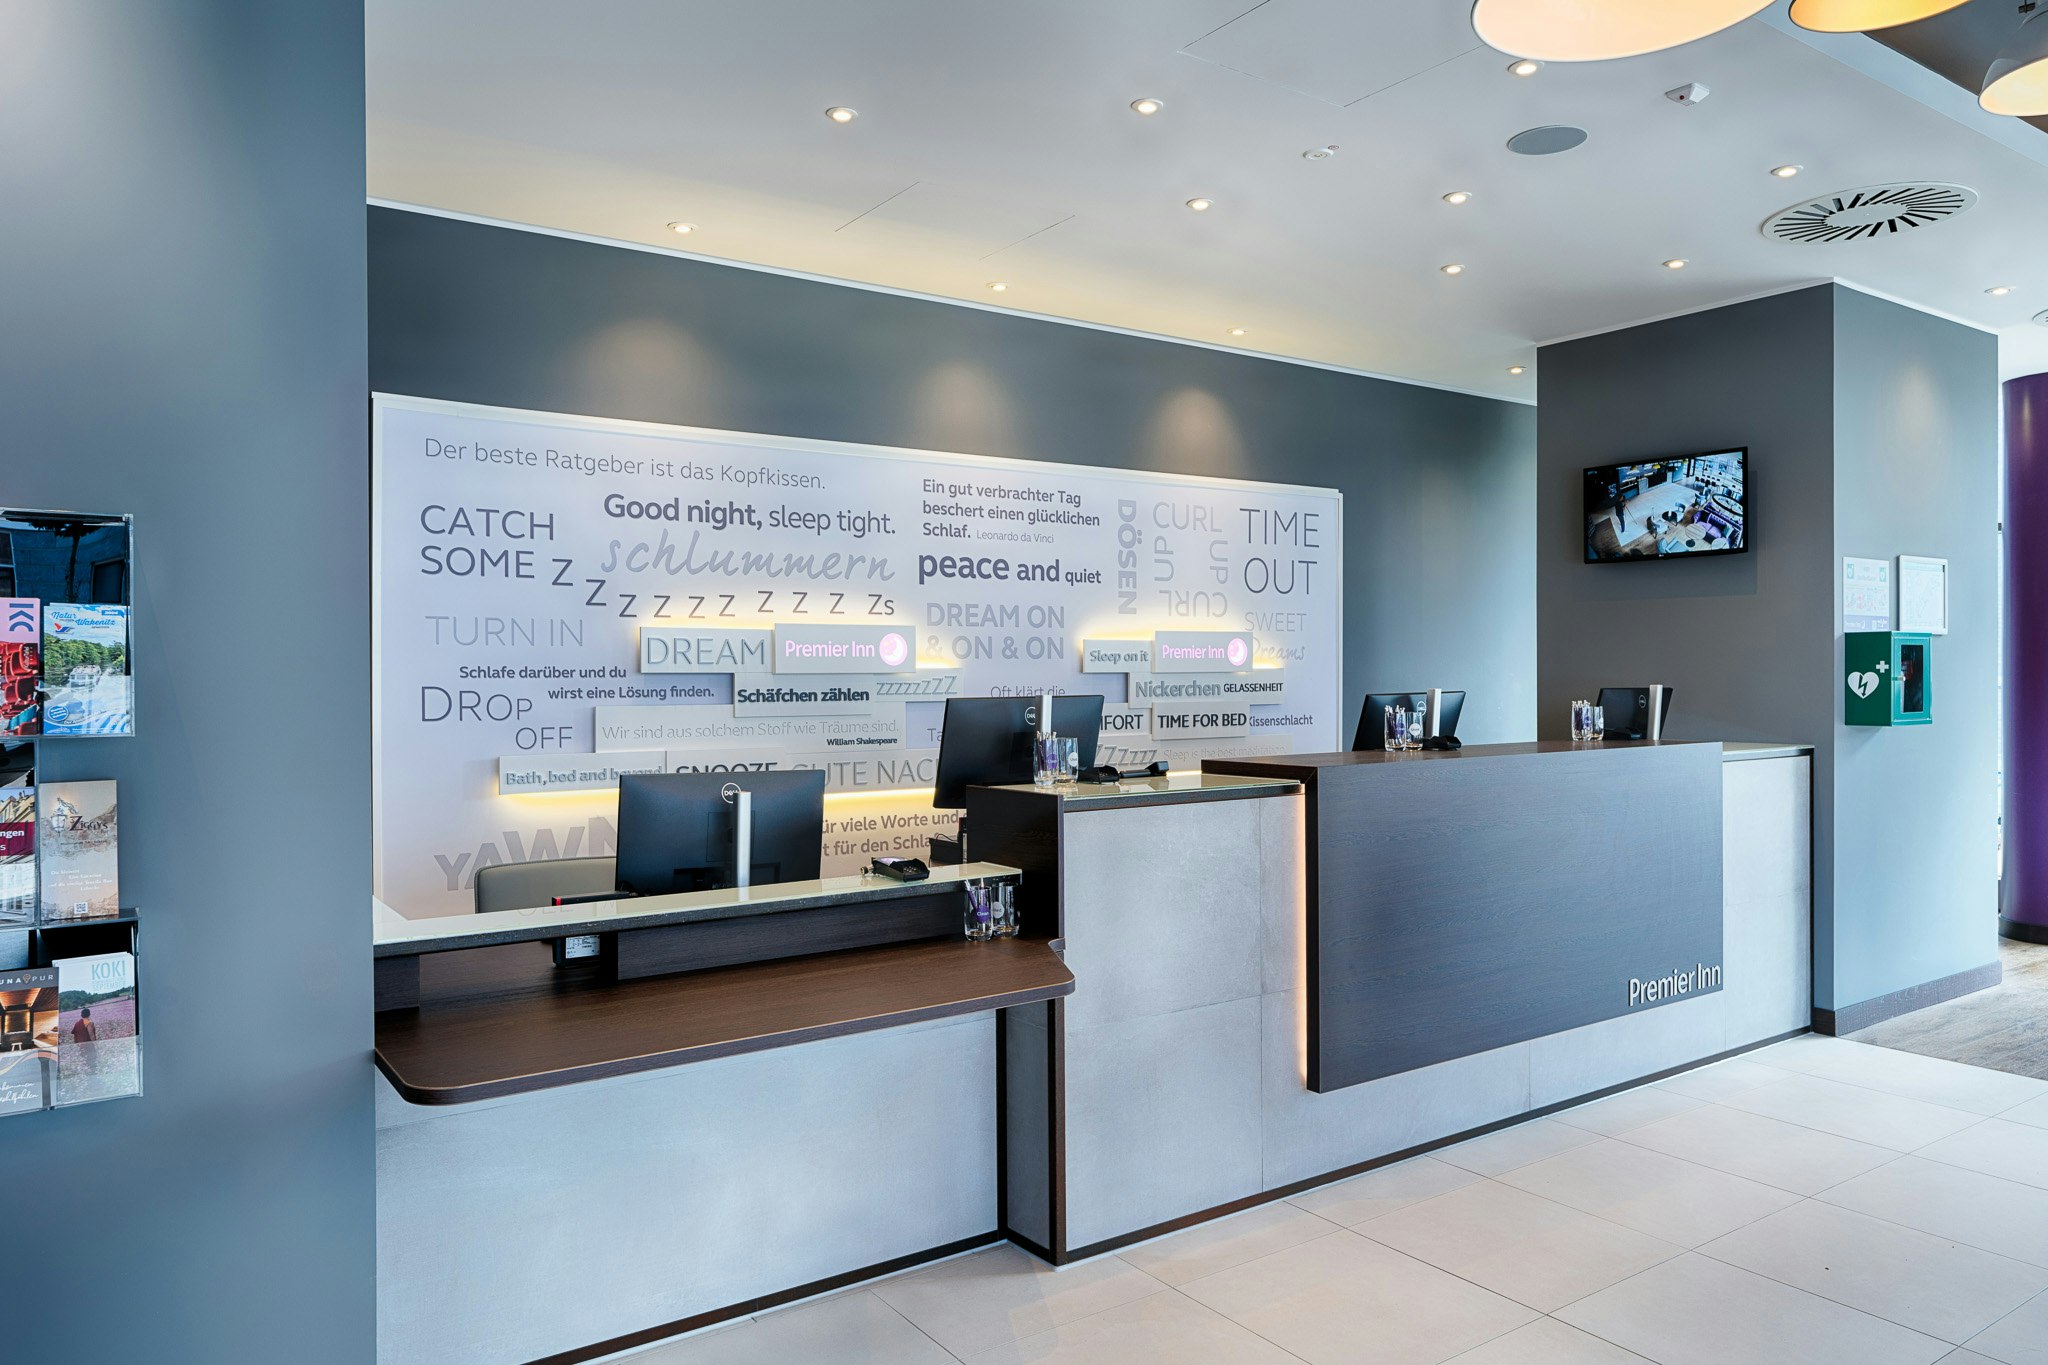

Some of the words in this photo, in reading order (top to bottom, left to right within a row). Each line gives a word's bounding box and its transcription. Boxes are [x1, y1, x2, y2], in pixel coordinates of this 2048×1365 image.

[424, 438, 467, 461] Der
[475, 443, 538, 467] beste
[546, 449, 644, 476] Ratgeber
[650, 460, 675, 479] ist
[680, 462, 715, 482] das
[720, 464, 826, 490] Kopfkissen.
[922, 479, 945, 494] Ein
[949, 483, 972, 498] gut
[976, 485, 1054, 503] verbrachter
[1058, 490, 1081, 508] Tag
[420, 504, 555, 541] CATCH
[603, 493, 680, 522] Good
[686, 500, 763, 532] night,
[768, 505, 831, 535] sleep
[837, 509, 896, 538] tight.
[922, 500, 984, 518] beschert
[987, 506, 1024, 521] einen
[1027, 509, 1100, 527] glücklichen
[1152, 501, 1223, 533] CURL
[922, 522, 971, 539] Schlaf.
[976, 529, 1019, 542] Leonardo
[1020, 531, 1032, 543] da
[1034, 533, 1054, 544] Vinci
[1240, 508, 1320, 548] TIME
[600, 528, 897, 582] schlummern
[1117, 499, 1143, 615] DÖSEN
[1154, 535, 1175, 582] UP
[1209, 540, 1229, 585] UP
[420, 545, 535, 579] SOME
[551, 558, 573, 587] Z
[585, 579, 607, 607] Z
[618, 593, 638, 618] Z
[653, 595, 672, 618] Z
[687, 596, 706, 618] Z
[718, 594, 736, 616] Z
[757, 590, 775, 613] Z
[791, 591, 809, 613] Z
[828, 592, 846, 614] Z
[867, 593, 896, 616] Zs
[918, 553, 1010, 585] peace
[1016, 558, 1060, 582] and
[1064, 568, 1102, 587] quiet
[1243, 557, 1318, 596] OUT
[926, 602, 1020, 629] DREAM
[1026, 604, 1065, 629] ON
[1159, 590, 1229, 618] CURL
[425, 616, 536, 647] TURN
[549, 618, 585, 647] IN
[1244, 611, 1307, 633] SWEET
[646, 636, 766, 666] DREAM
[785, 639, 850, 659] Premier
[851, 640, 876, 657] Inn
[951, 635, 993, 660] ON
[1001, 636, 1020, 660] &
[1025, 636, 1064, 660] ON
[1090, 649, 1121, 664] Sleep
[1124, 652, 1139, 662] on
[1140, 649, 1149, 662] it
[1162, 643, 1206, 660] Premier
[1208, 645, 1225, 660] Inn
[459, 666, 516, 679] Schlafe
[518, 665, 576, 680] darüber
[579, 666, 606, 679] und
[609, 665, 627, 678] du
[548, 687, 583, 700] wirst
[587, 687, 614, 699] eine
[619, 686, 667, 701] Lösung
[671, 686, 715, 699] finden.
[738, 688, 818, 703] Schäfchen
[821, 687, 870, 702] zählen
[990, 685, 1012, 698] Oft
[1015, 685, 1044, 696] klärt
[1047, 685, 1066, 696] die
[1135, 680, 1221, 698] Nickerchen
[1223, 682, 1284, 693] GELASSENHEIT
[422, 686, 533, 722] DROP
[602, 726, 630, 740] Wir
[633, 725, 663, 739] sind
[666, 727, 692, 738] aus
[695, 723, 754, 738] solchem
[758, 722, 791, 737] Stoff
[795, 722, 817, 735] wie
[819, 720, 867, 735] Träume
[871, 719, 899, 733] sind.
[1101, 714, 1144, 731] FORT
[1157, 714, 1189, 729] TIME
[1192, 713, 1219, 728] FOR
[1221, 713, 1247, 727] BED
[515, 727, 573, 750] OFF
[826, 738, 856, 747] William
[856, 738, 898, 747] Shakespeare
[1163, 749, 1187, 762] Sleep
[1201, 747, 1216, 759] the
[506, 771, 546, 786] Bath,
[549, 771, 576, 784] bed
[580, 768, 607, 782] and
[877, 758, 939, 784] NAC
[822, 818, 837, 833] ür
[841, 816, 877, 832] viele
[881, 814, 928, 829] Worte
[932, 810, 959, 824] und
[834, 840, 857, 855] für
[861, 839, 889, 853] den
[893, 833, 938, 850] Schla
[32, 974, 54, 982] PUR
[91, 960, 127, 980] KOKI
[1628, 968, 1696, 1006] Premier
[1697, 963, 1721, 989] Inn
